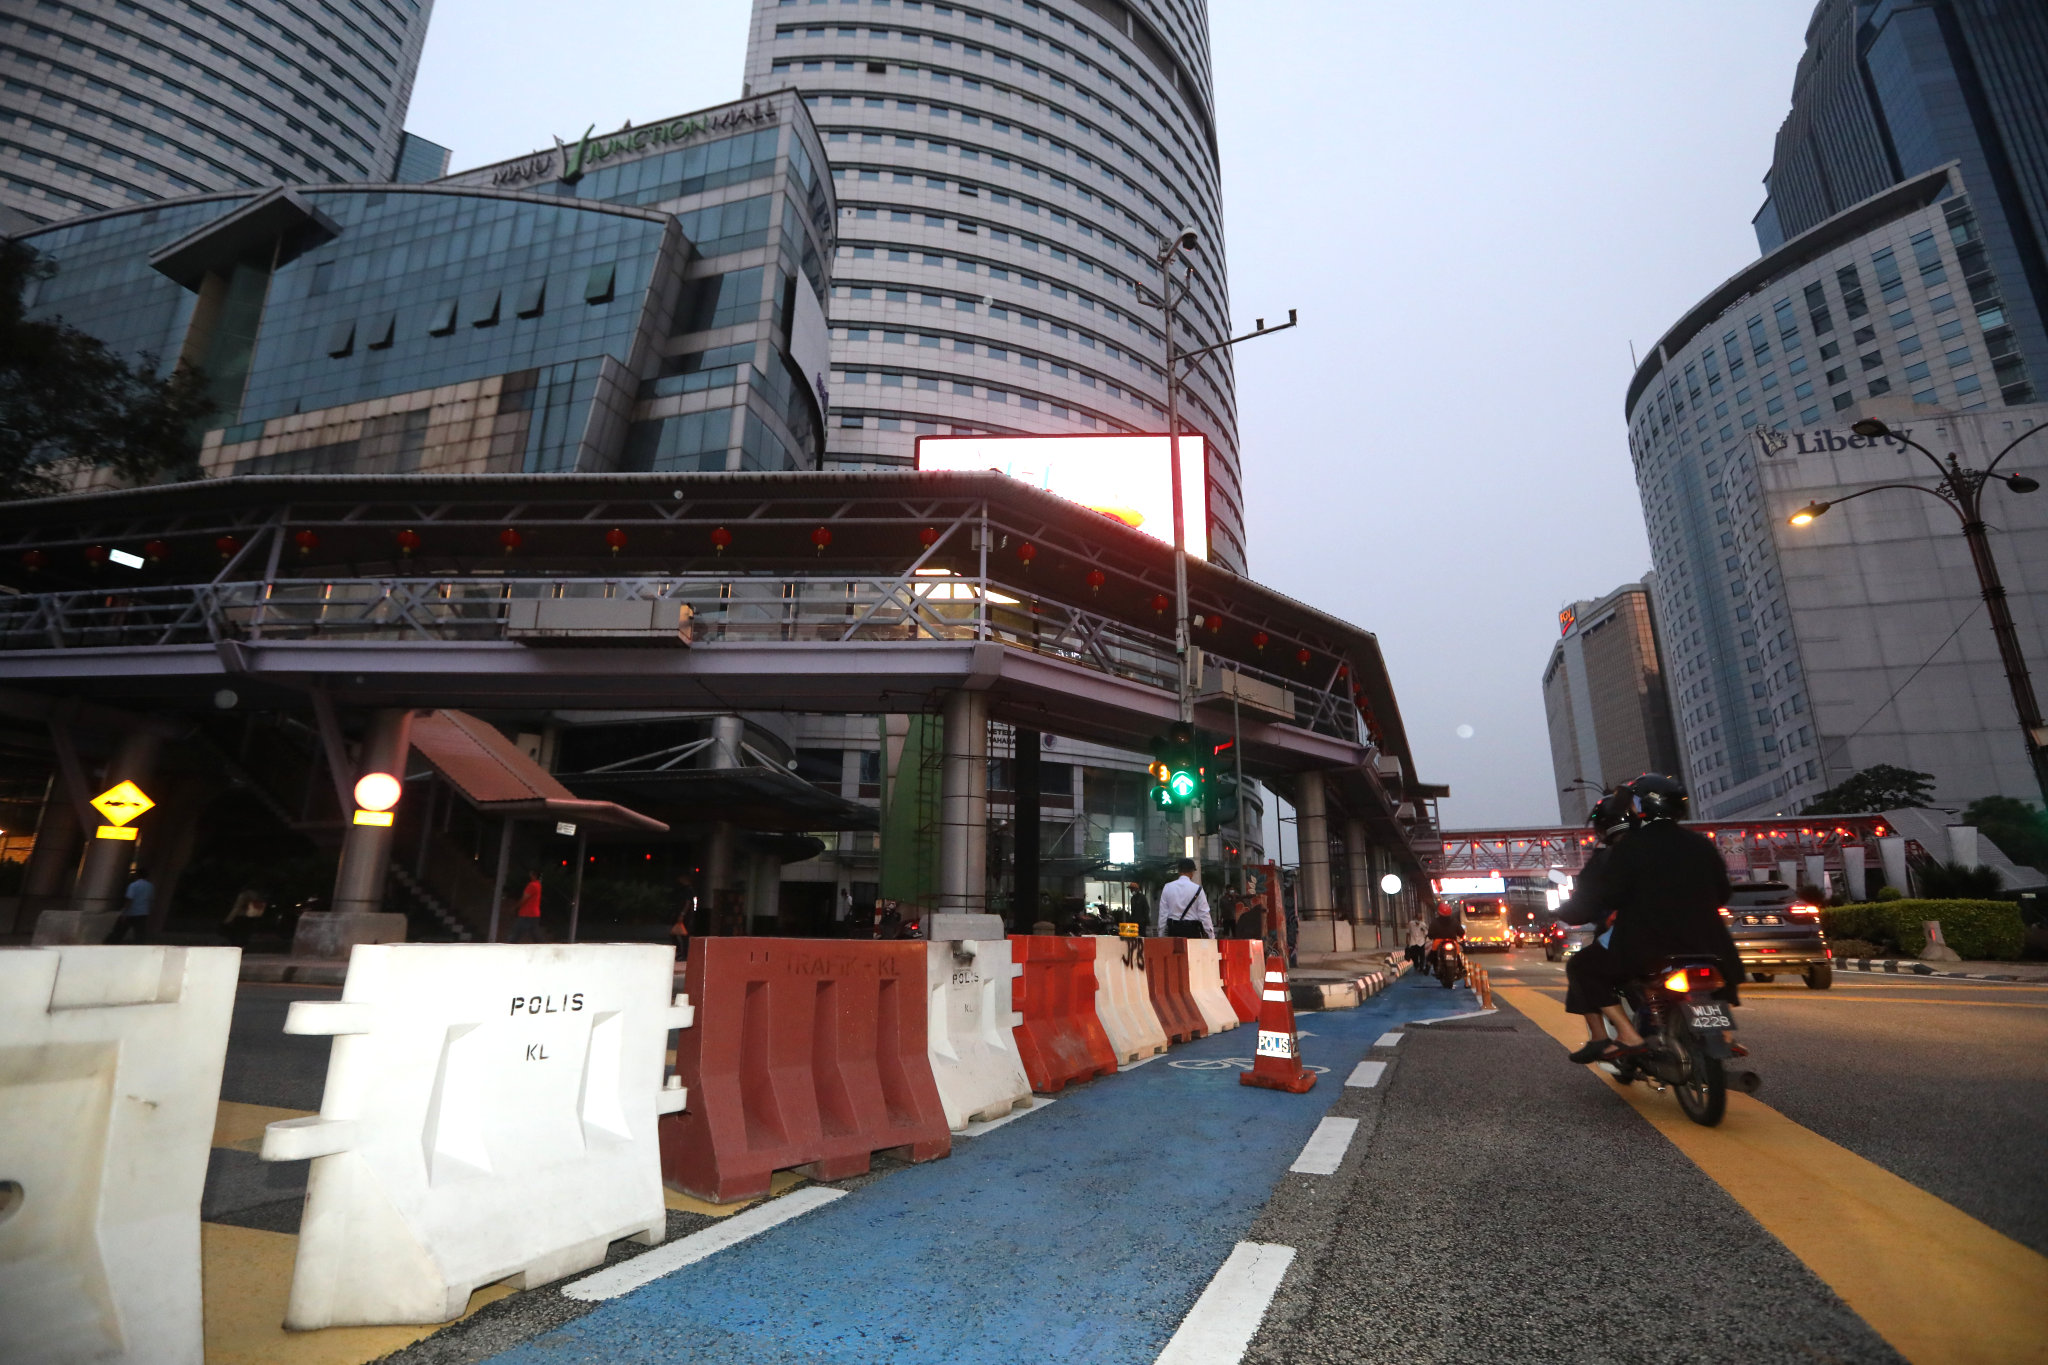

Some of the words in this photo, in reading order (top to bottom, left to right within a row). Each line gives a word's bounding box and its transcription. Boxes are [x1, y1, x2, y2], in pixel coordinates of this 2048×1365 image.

[1793, 428, 1913, 455] Liberty
[510, 993, 584, 1016] POLIS
[1692, 1005, 1721, 1016] WUH
[1693, 1016, 1730, 1027] 4228
[526, 1043, 550, 1061] KL
[1258, 1036, 1290, 1053] POLIS
